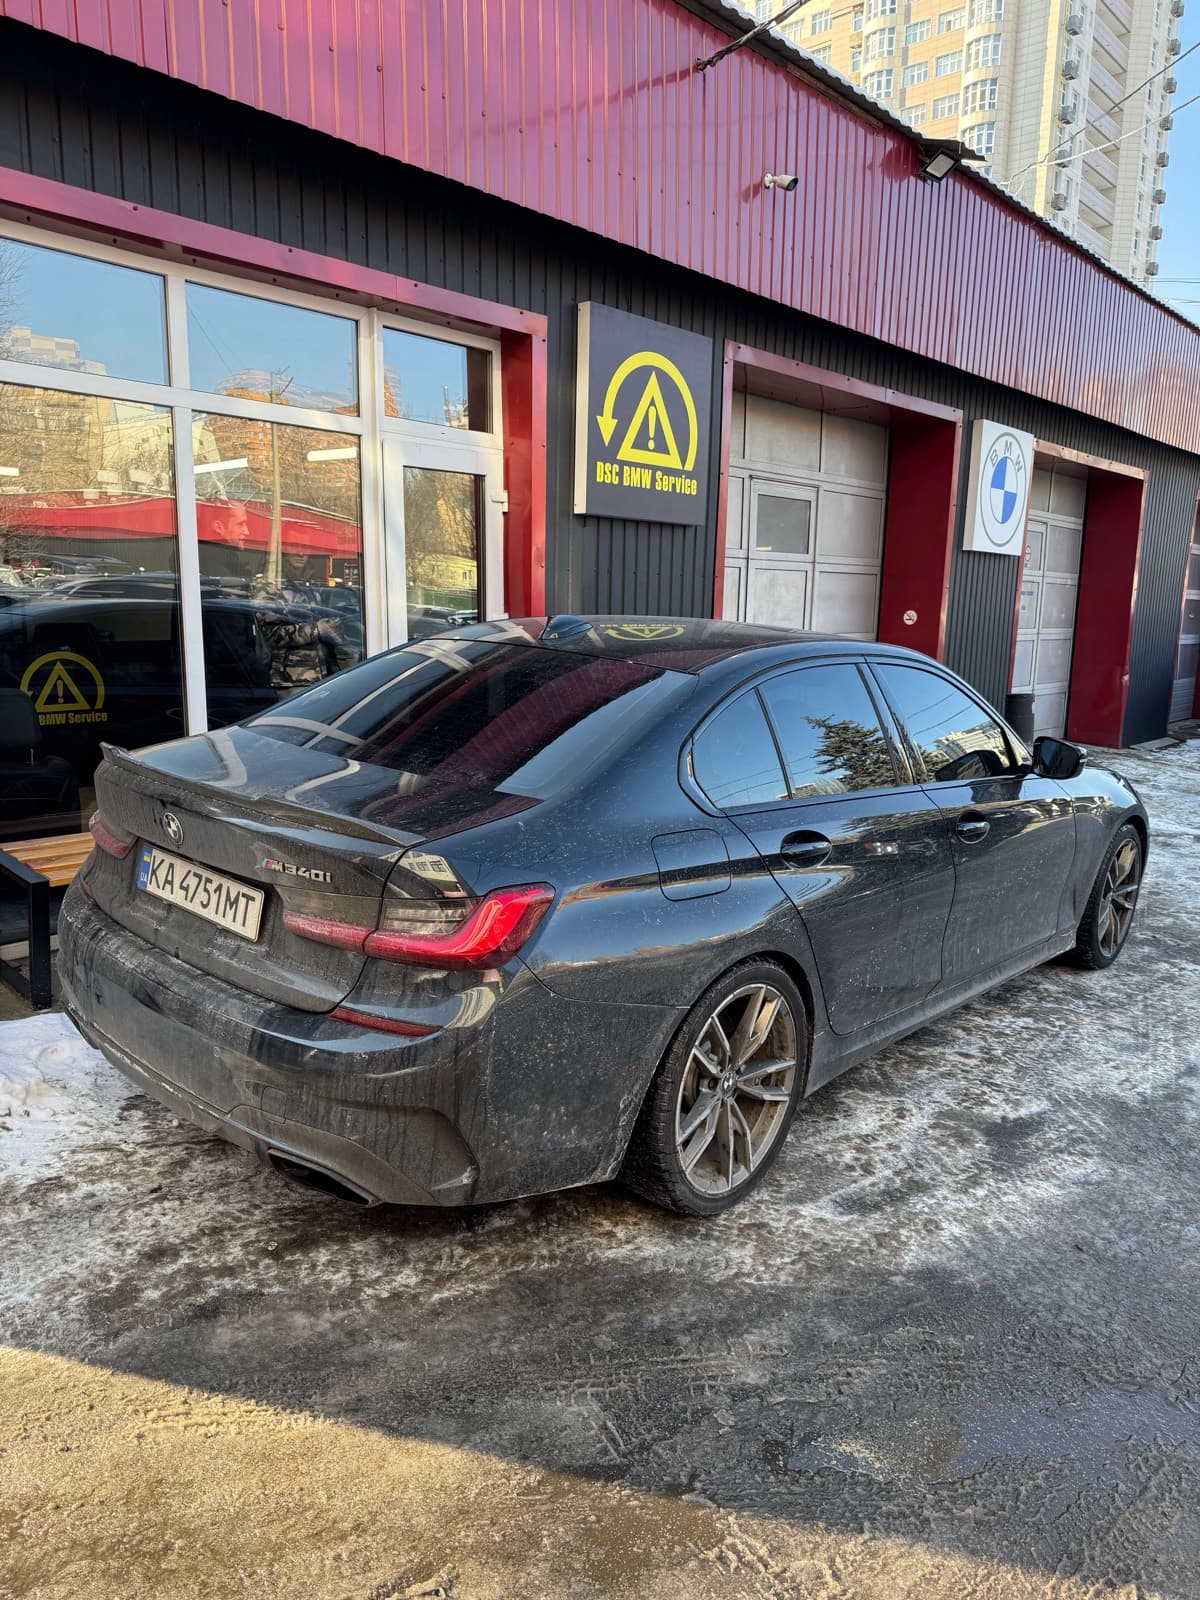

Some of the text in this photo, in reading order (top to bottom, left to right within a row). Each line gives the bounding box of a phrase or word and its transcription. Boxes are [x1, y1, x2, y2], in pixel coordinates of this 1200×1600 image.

[989, 439, 1023, 473] BMW
[596, 461, 698, 496] DSC BMW Service
[38, 711, 108, 726] BMW Service
[268, 860, 332, 884] M340i
